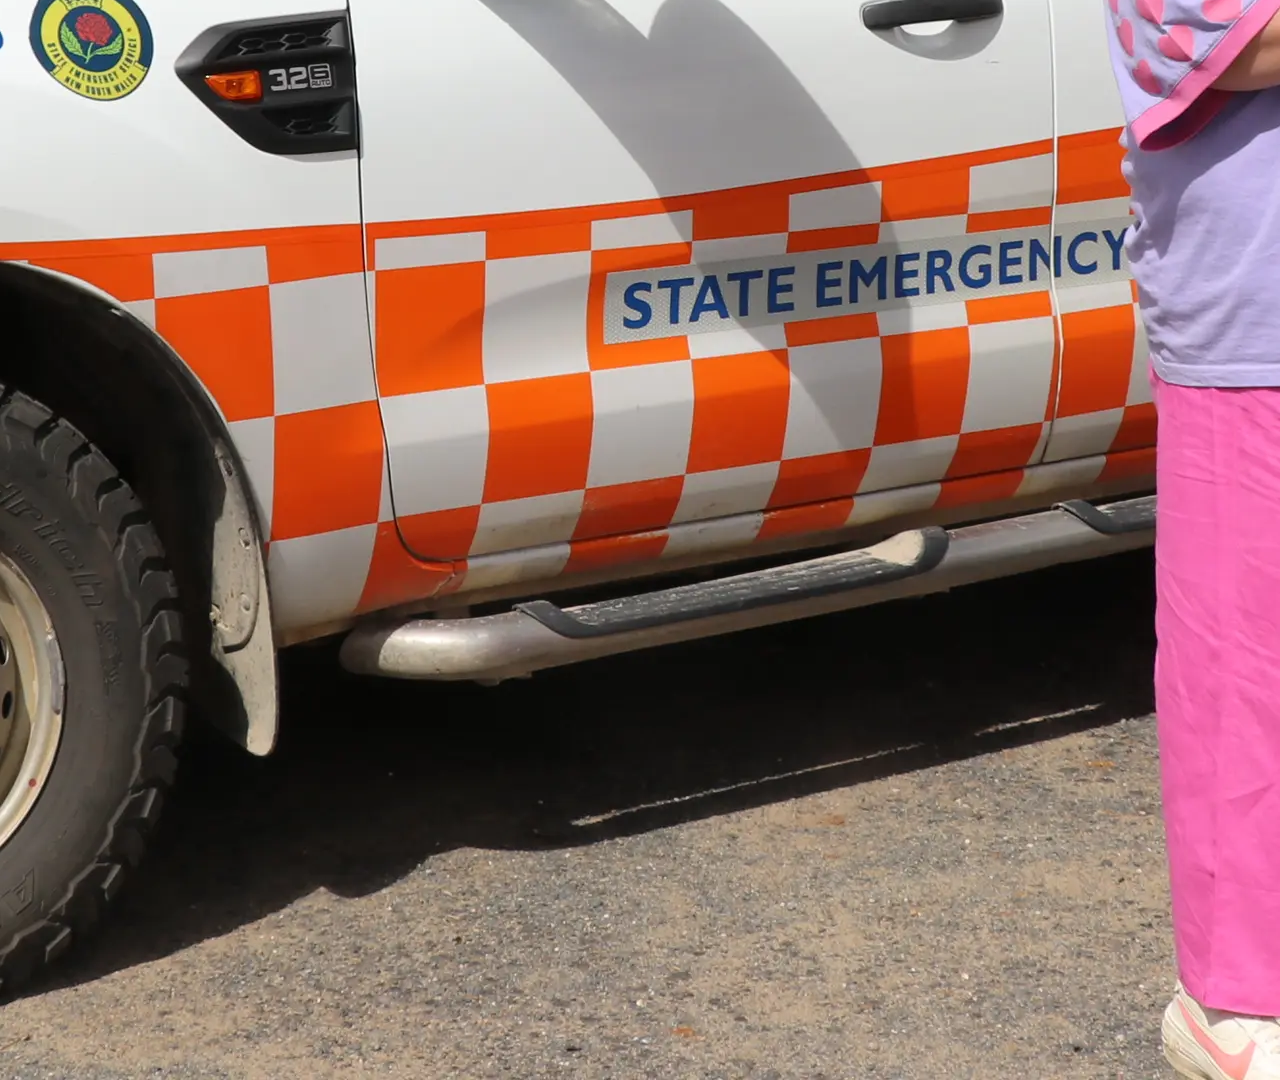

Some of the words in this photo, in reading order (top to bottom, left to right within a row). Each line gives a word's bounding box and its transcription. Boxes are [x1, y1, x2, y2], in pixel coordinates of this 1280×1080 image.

[47, 42, 67, 68] STATE
[69, 67, 119, 84] EMERGENCY
[118, 38, 137, 73] SERVICE
[268, 66, 308, 91] 3.2
[65, 76, 82, 90] NEW
[85, 86, 112, 96] SOUTH
[114, 73, 137, 93] WALES
[623, 265, 795, 329] STATE
[816, 227, 1128, 307] EMERGENCY
